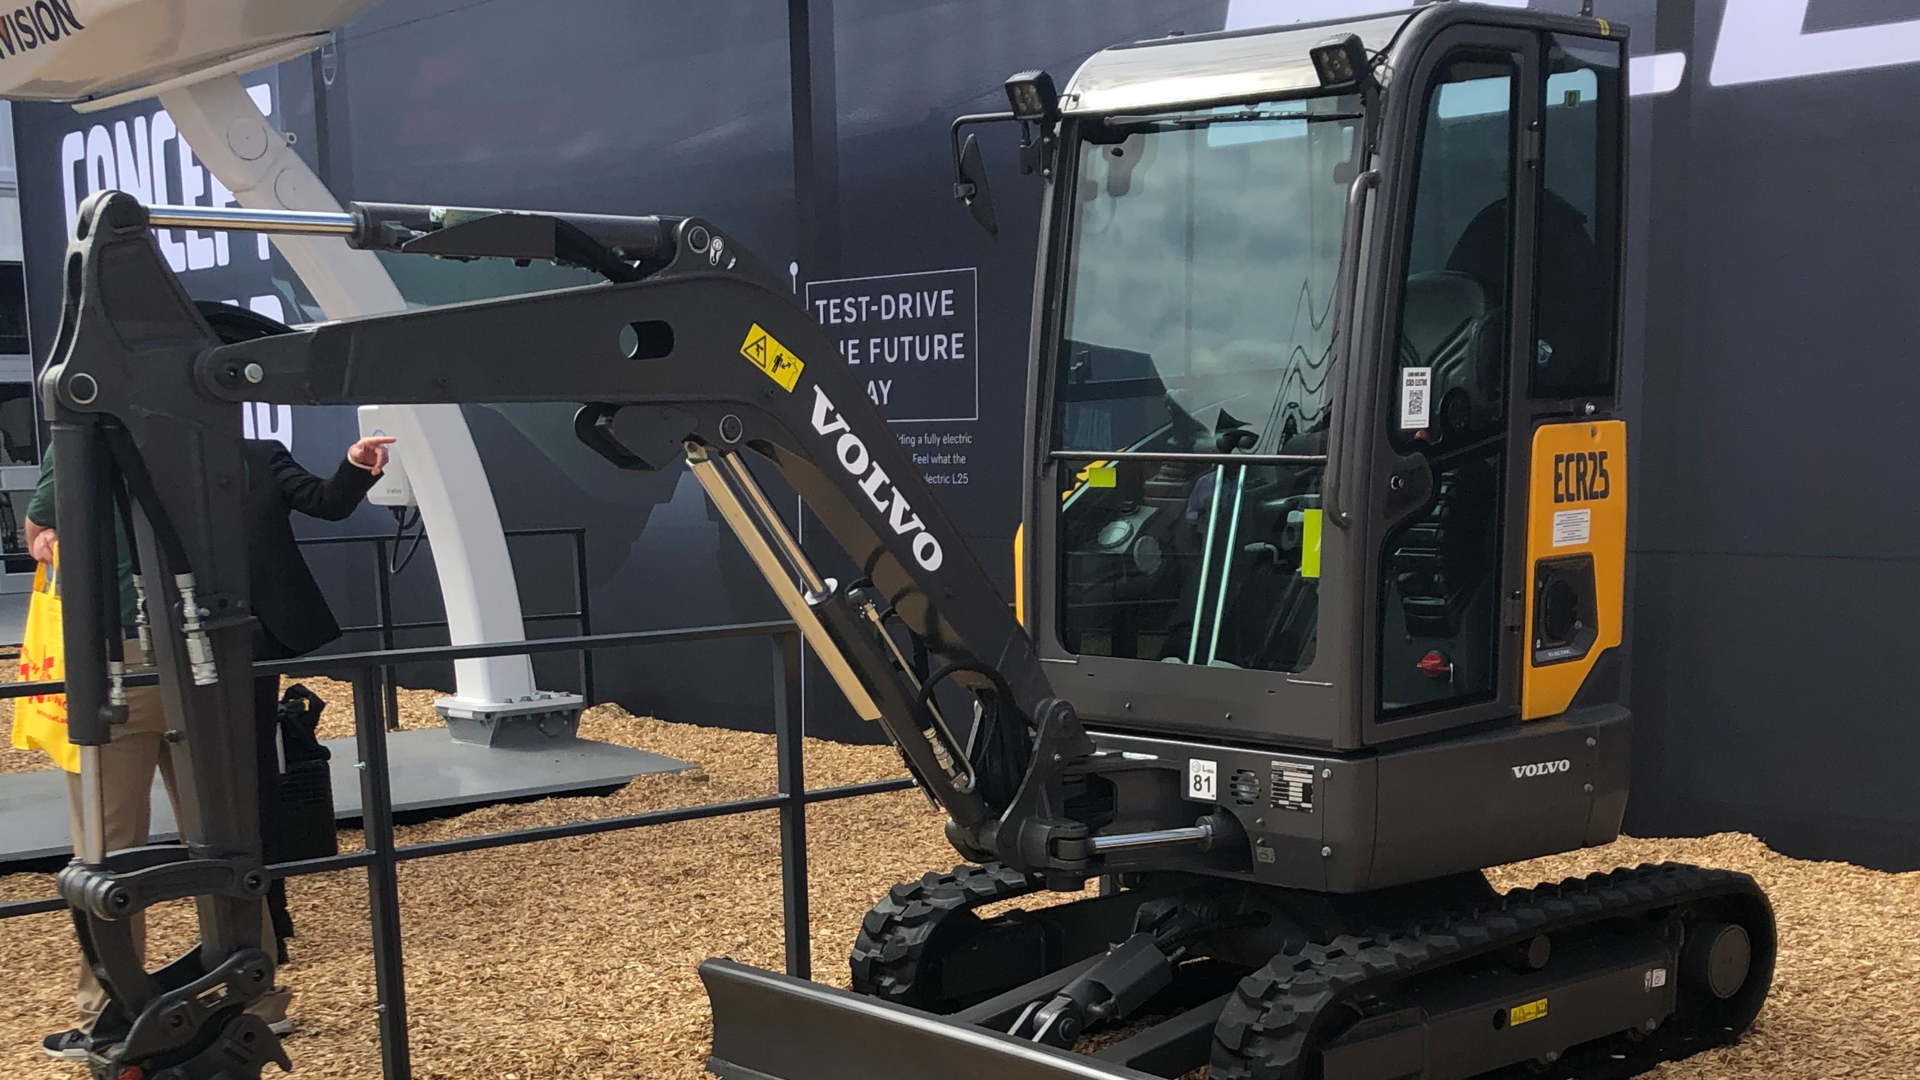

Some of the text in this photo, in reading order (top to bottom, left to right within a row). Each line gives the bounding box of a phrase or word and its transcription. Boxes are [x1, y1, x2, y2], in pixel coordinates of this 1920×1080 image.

[0, 0, 85, 59] VISION
[815, 289, 955, 325] TEST-DRIVE
[869, 332, 966, 364] FUTURE
[917, 436, 923, 445] a
[924, 433, 942, 447] fully
[942, 433, 973, 445] electric
[912, 453, 967, 465] Feel what the
[811, 384, 944, 572] VOLVO
[952, 473, 969, 485] L25
[1553, 451, 1611, 503] ECR25
[1511, 759, 1570, 778] VOLVO
[1193, 774, 1211, 793] 81
